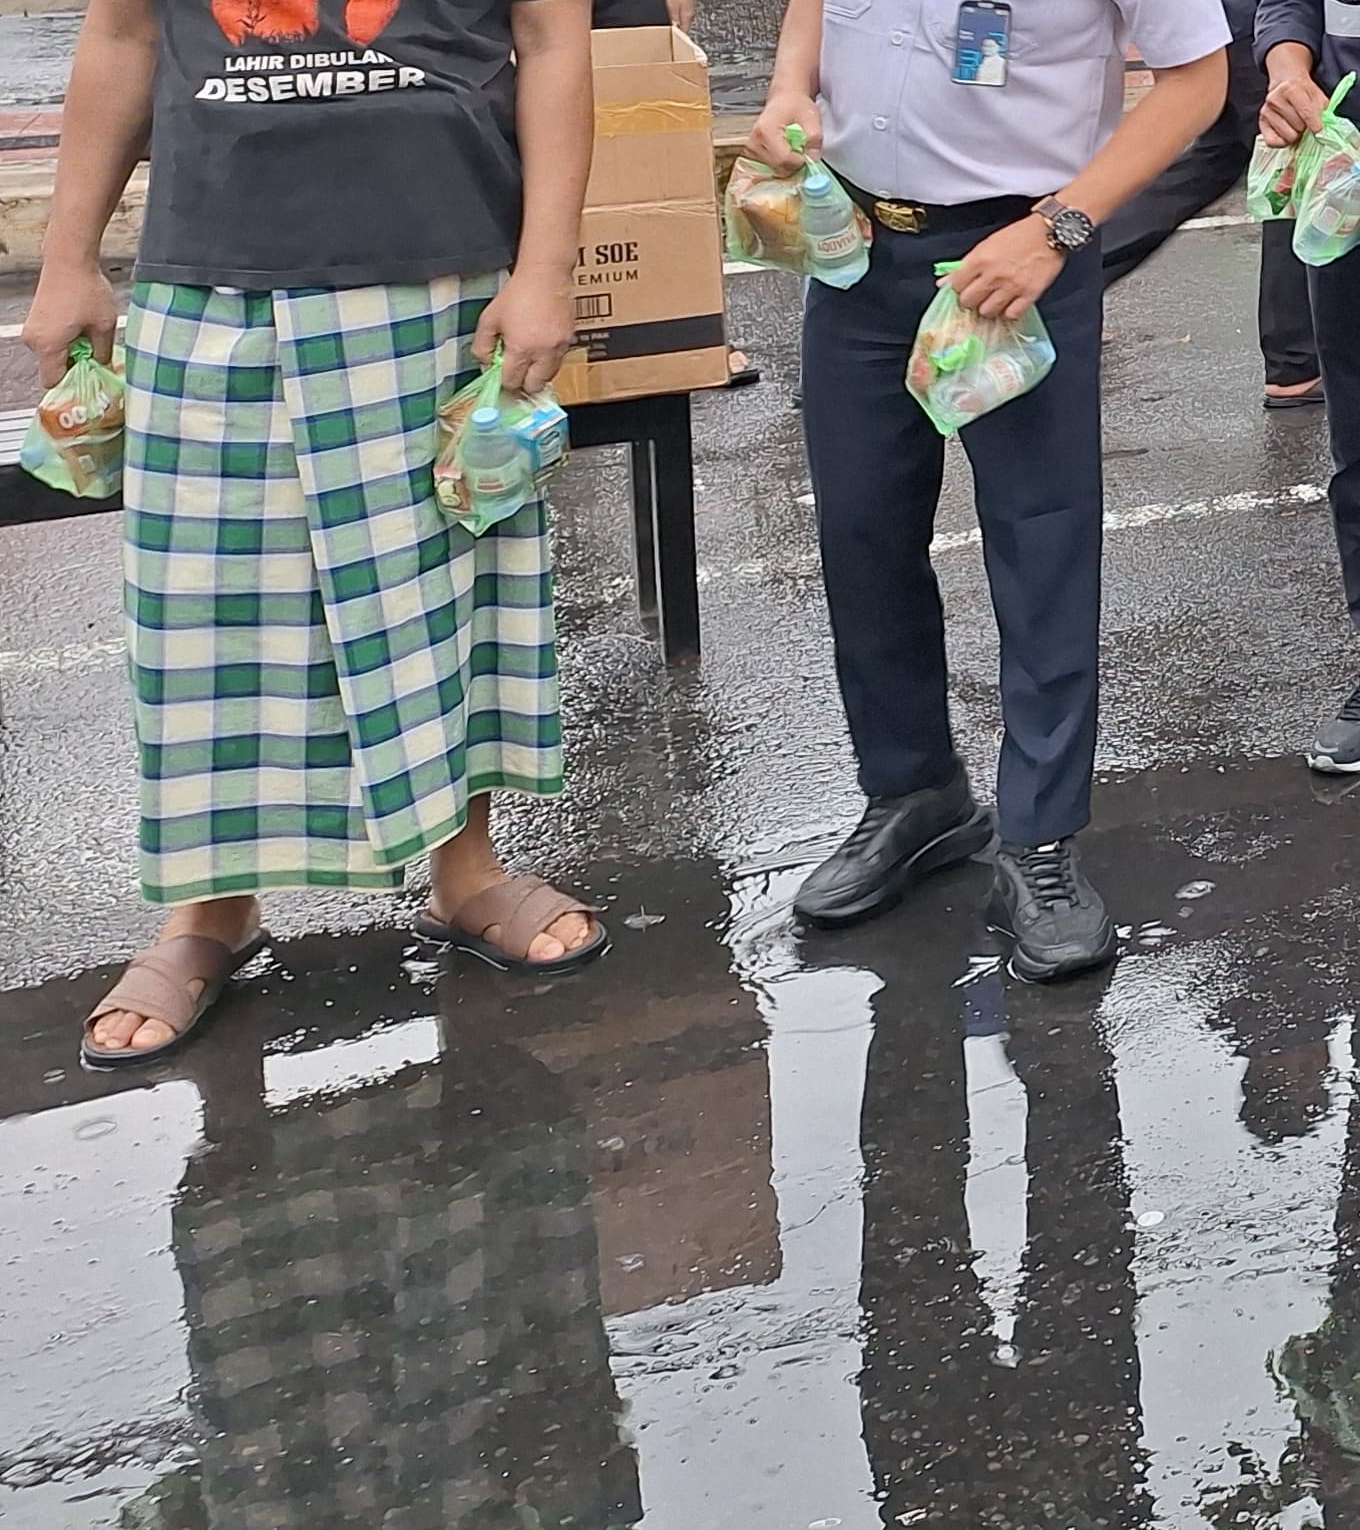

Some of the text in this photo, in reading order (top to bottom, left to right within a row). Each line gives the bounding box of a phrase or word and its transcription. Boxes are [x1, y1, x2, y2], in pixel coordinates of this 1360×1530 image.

[225, 55, 284, 72] LAHIR
[195, 67, 427, 102] DESEMBER
[595, 241, 639, 265] SOE
[577, 270, 639, 286] EMIUM
